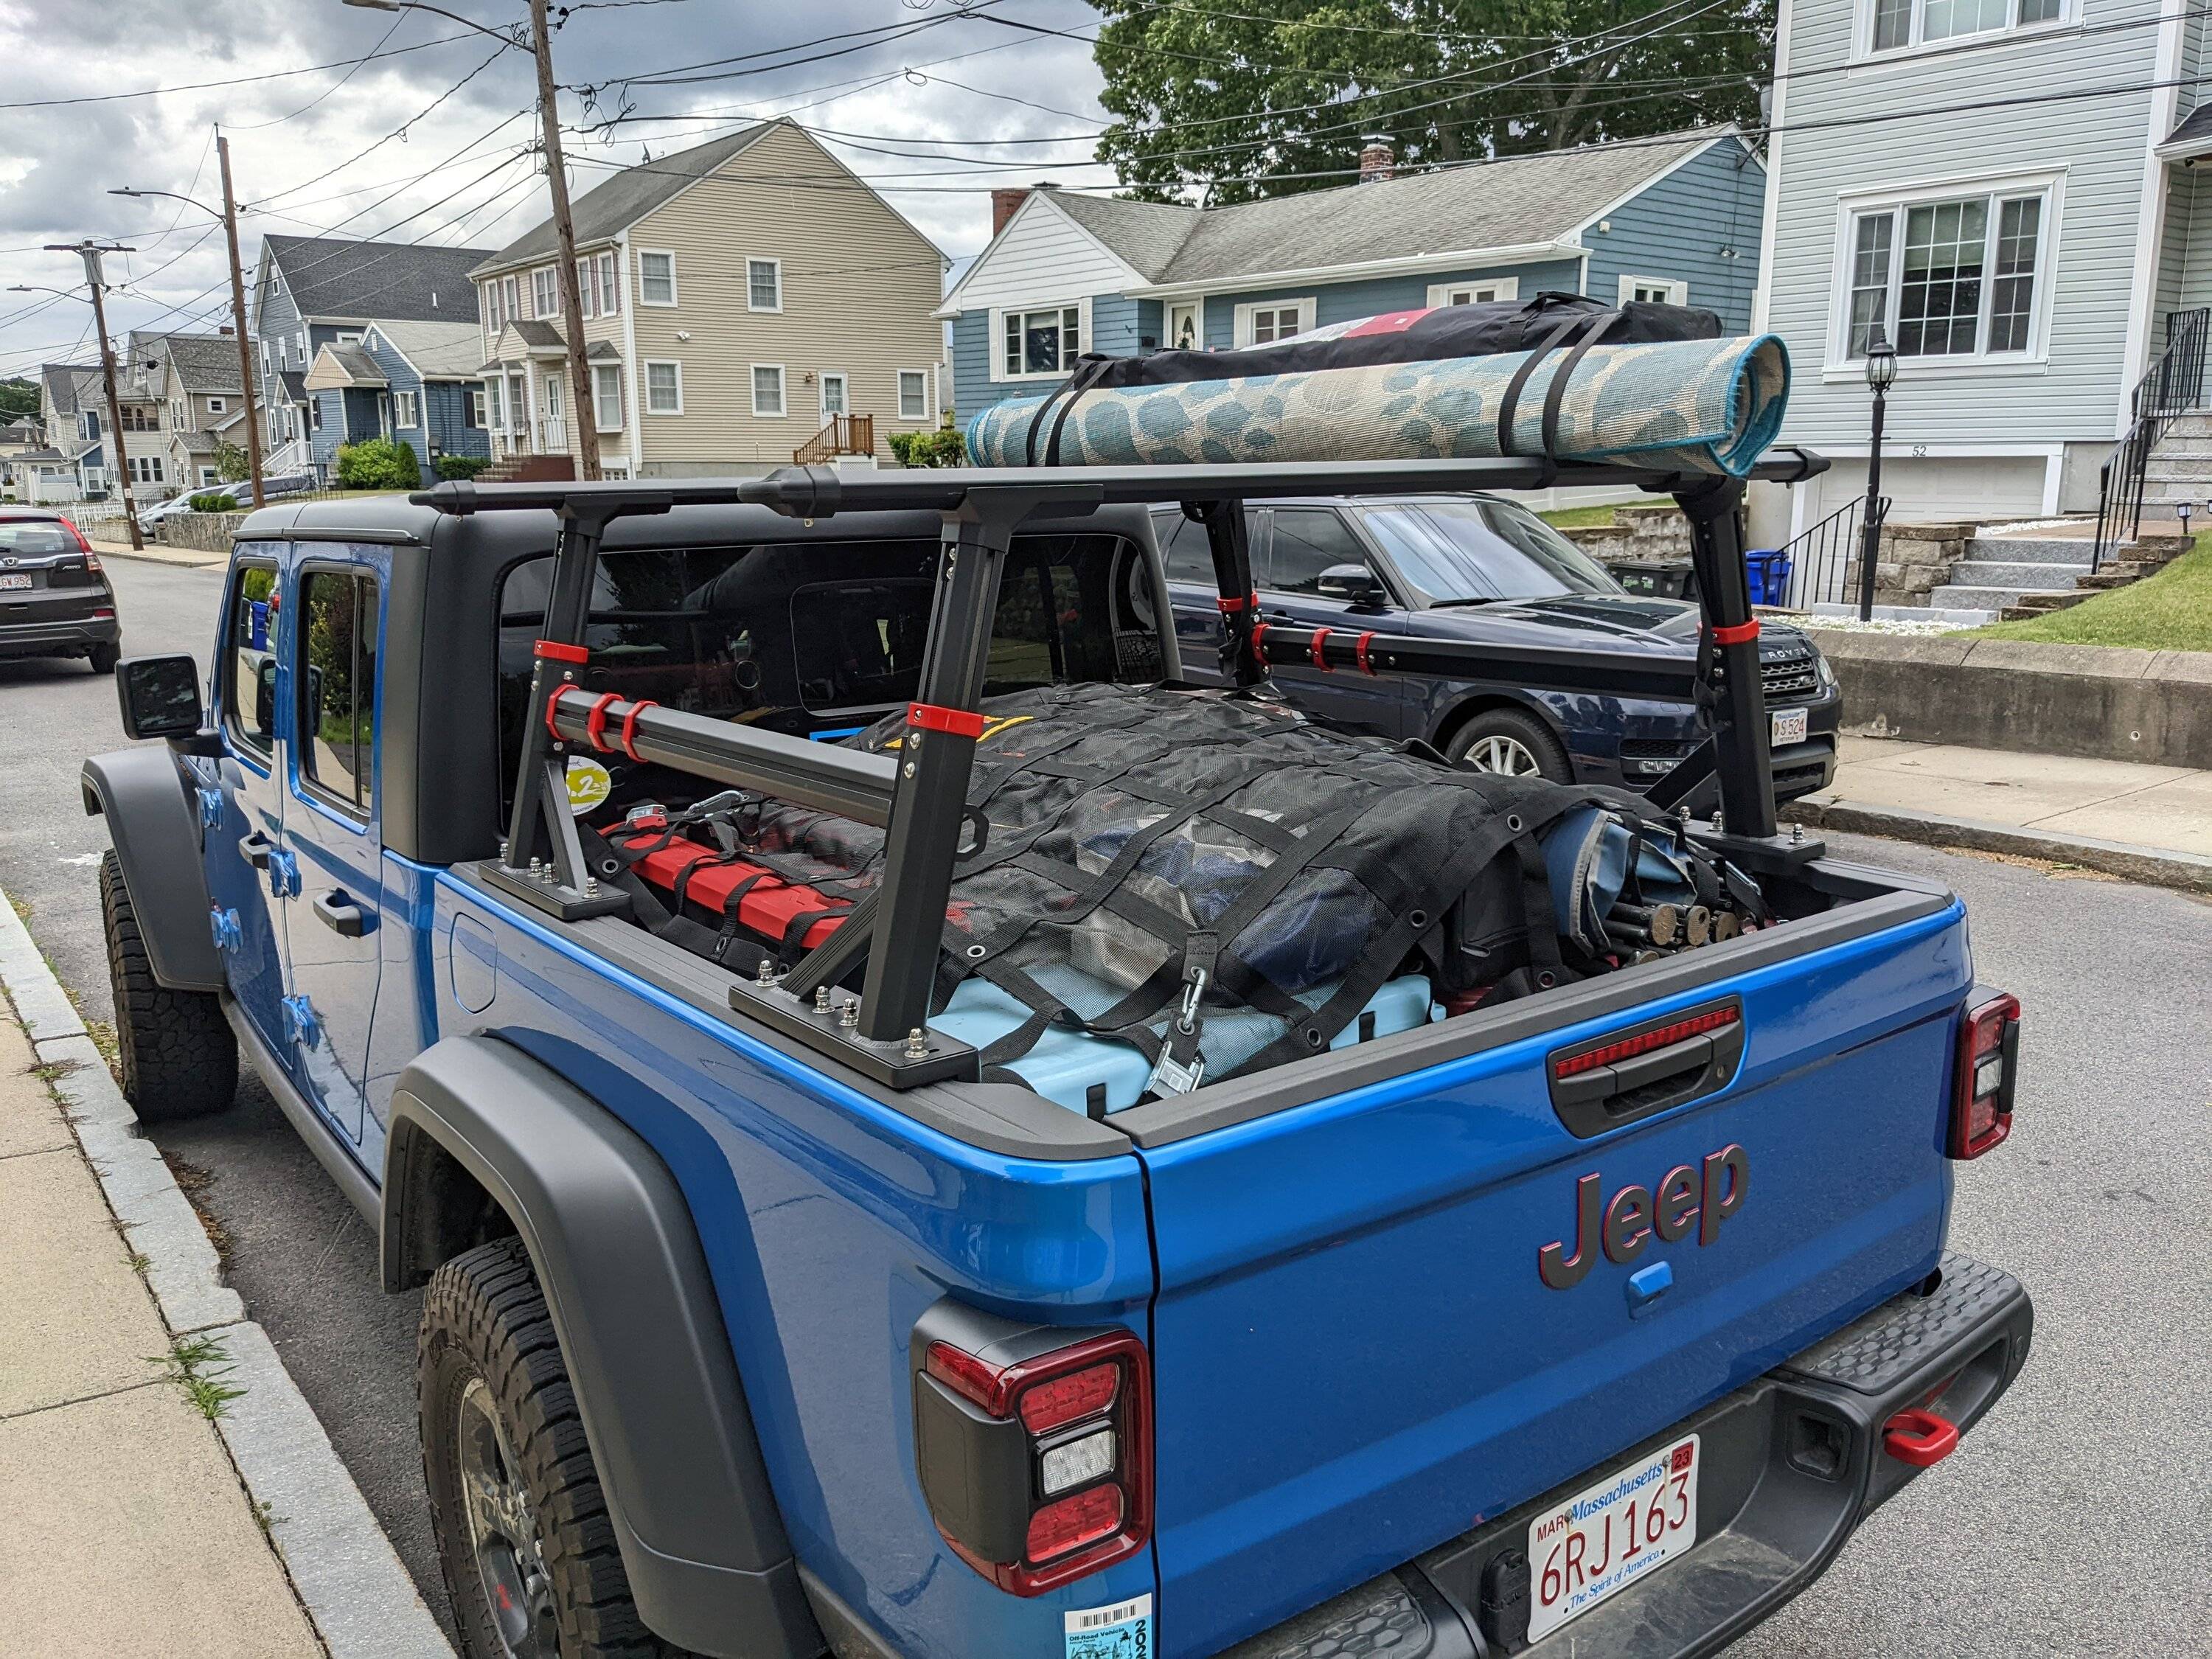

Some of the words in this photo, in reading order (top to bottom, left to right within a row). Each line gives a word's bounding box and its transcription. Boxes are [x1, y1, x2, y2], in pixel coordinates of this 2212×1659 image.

[1912, 445, 1927, 457] 52
[0, 577, 13, 587] GW
[14, 574, 31, 585] 952
[1767, 647, 1807, 658] ROVER
[1539, 1143, 1750, 1290] Jeep
[1674, 1450, 1691, 1470] 23
[1571, 1462, 1663, 1523] Massachusetts
[1537, 1514, 1563, 1543] MAR
[1540, 1514, 1610, 1606] 6RJ
[1621, 1470, 1689, 1561] 163
[1570, 1593, 1587, 1610] The
[1589, 1576, 1613, 1599] Spirit
[1614, 1566, 1624, 1583] of
[1624, 1549, 1660, 1577] America
[1069, 1632, 1099, 1641] Off-Road
[1100, 1627, 1125, 1637] Vehicle
[1135, 1619, 1147, 1659] 202
